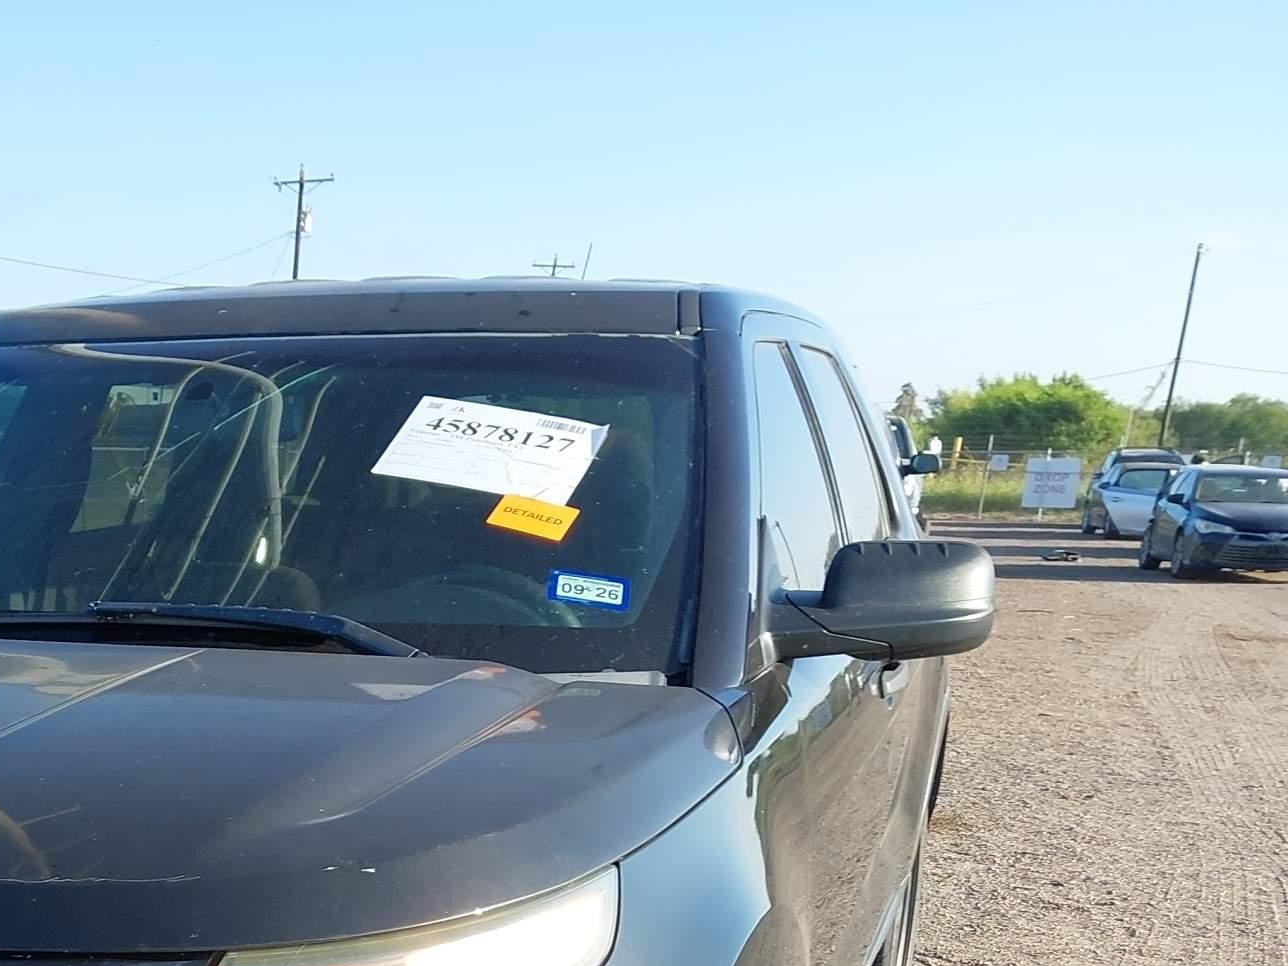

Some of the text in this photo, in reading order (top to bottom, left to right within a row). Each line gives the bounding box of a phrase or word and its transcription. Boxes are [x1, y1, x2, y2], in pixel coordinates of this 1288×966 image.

[425, 416, 575, 453] 45878127
[1033, 472, 1070, 482] DROP
[1032, 484, 1066, 494] ZONE
[503, 506, 563, 526] DETAILED
